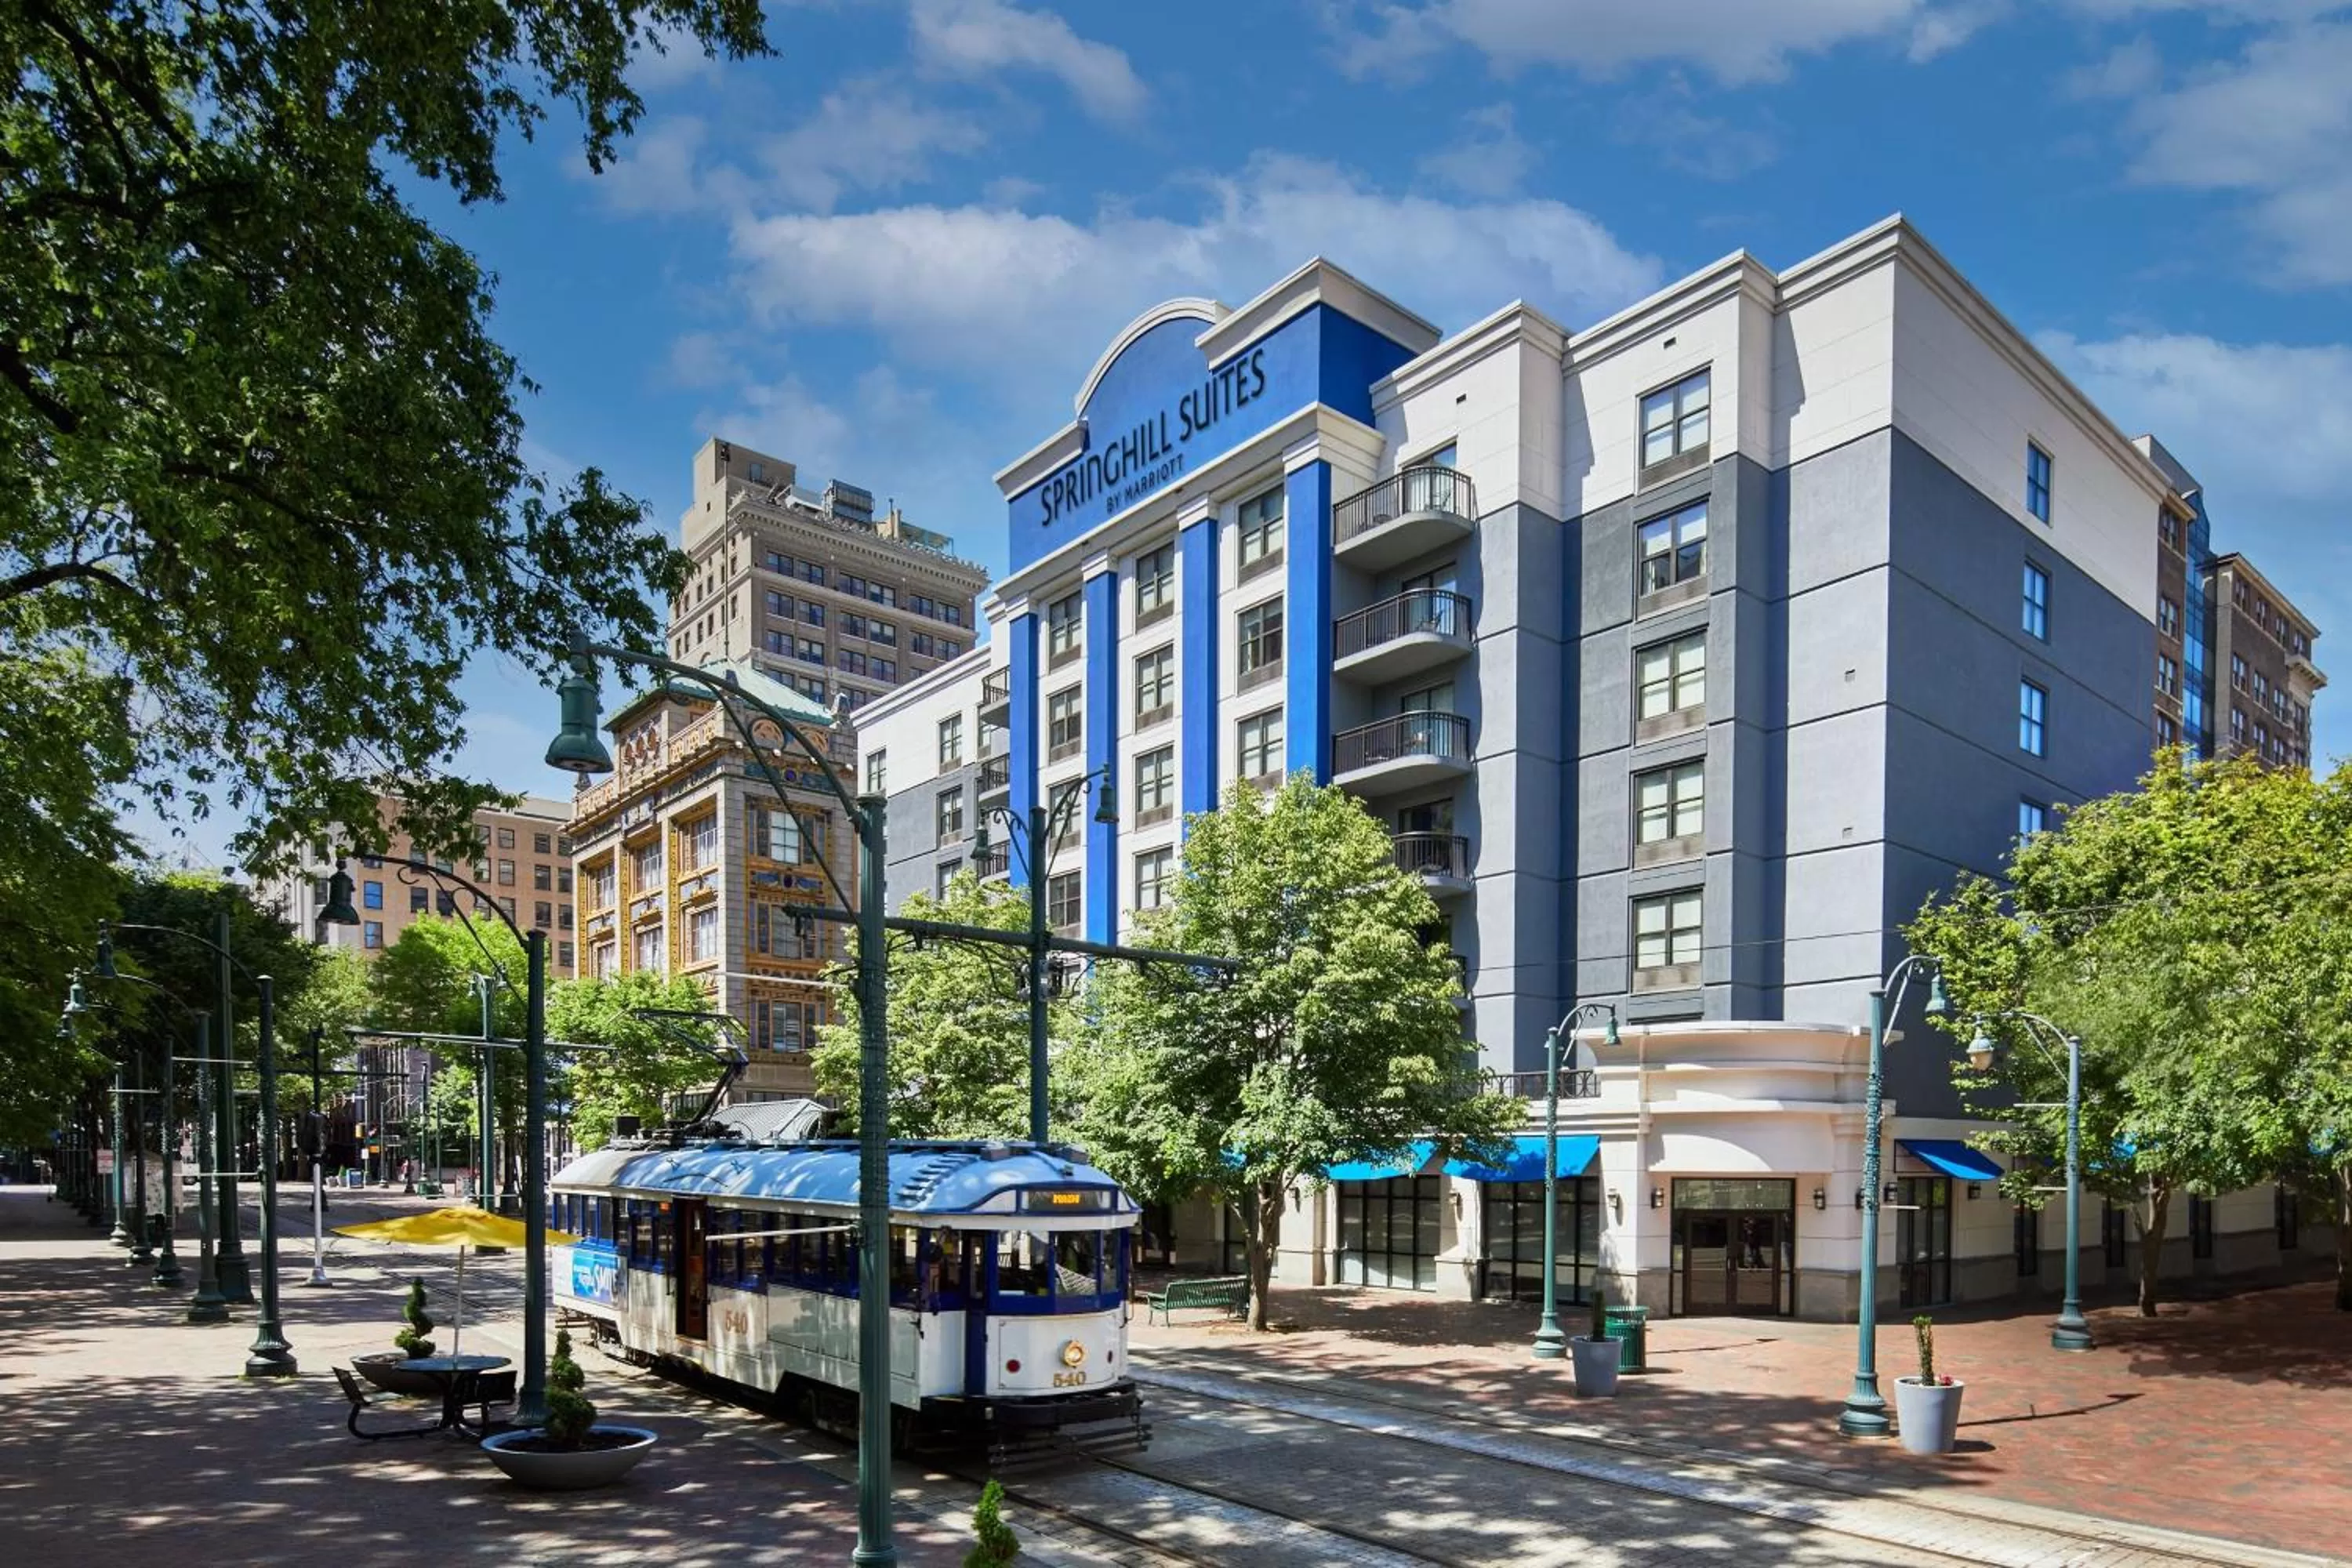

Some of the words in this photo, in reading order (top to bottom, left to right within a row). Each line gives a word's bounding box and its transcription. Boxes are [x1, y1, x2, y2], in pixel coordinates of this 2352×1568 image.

[1041, 410, 1172, 527] SPRINGHILL
[1179, 348, 1265, 441] SUITES
[1106, 493, 1122, 514] BY
[1124, 453, 1183, 501] MARRIOTT
[725, 1309, 749, 1334] 540
[1053, 1370, 1087, 1388] 540
